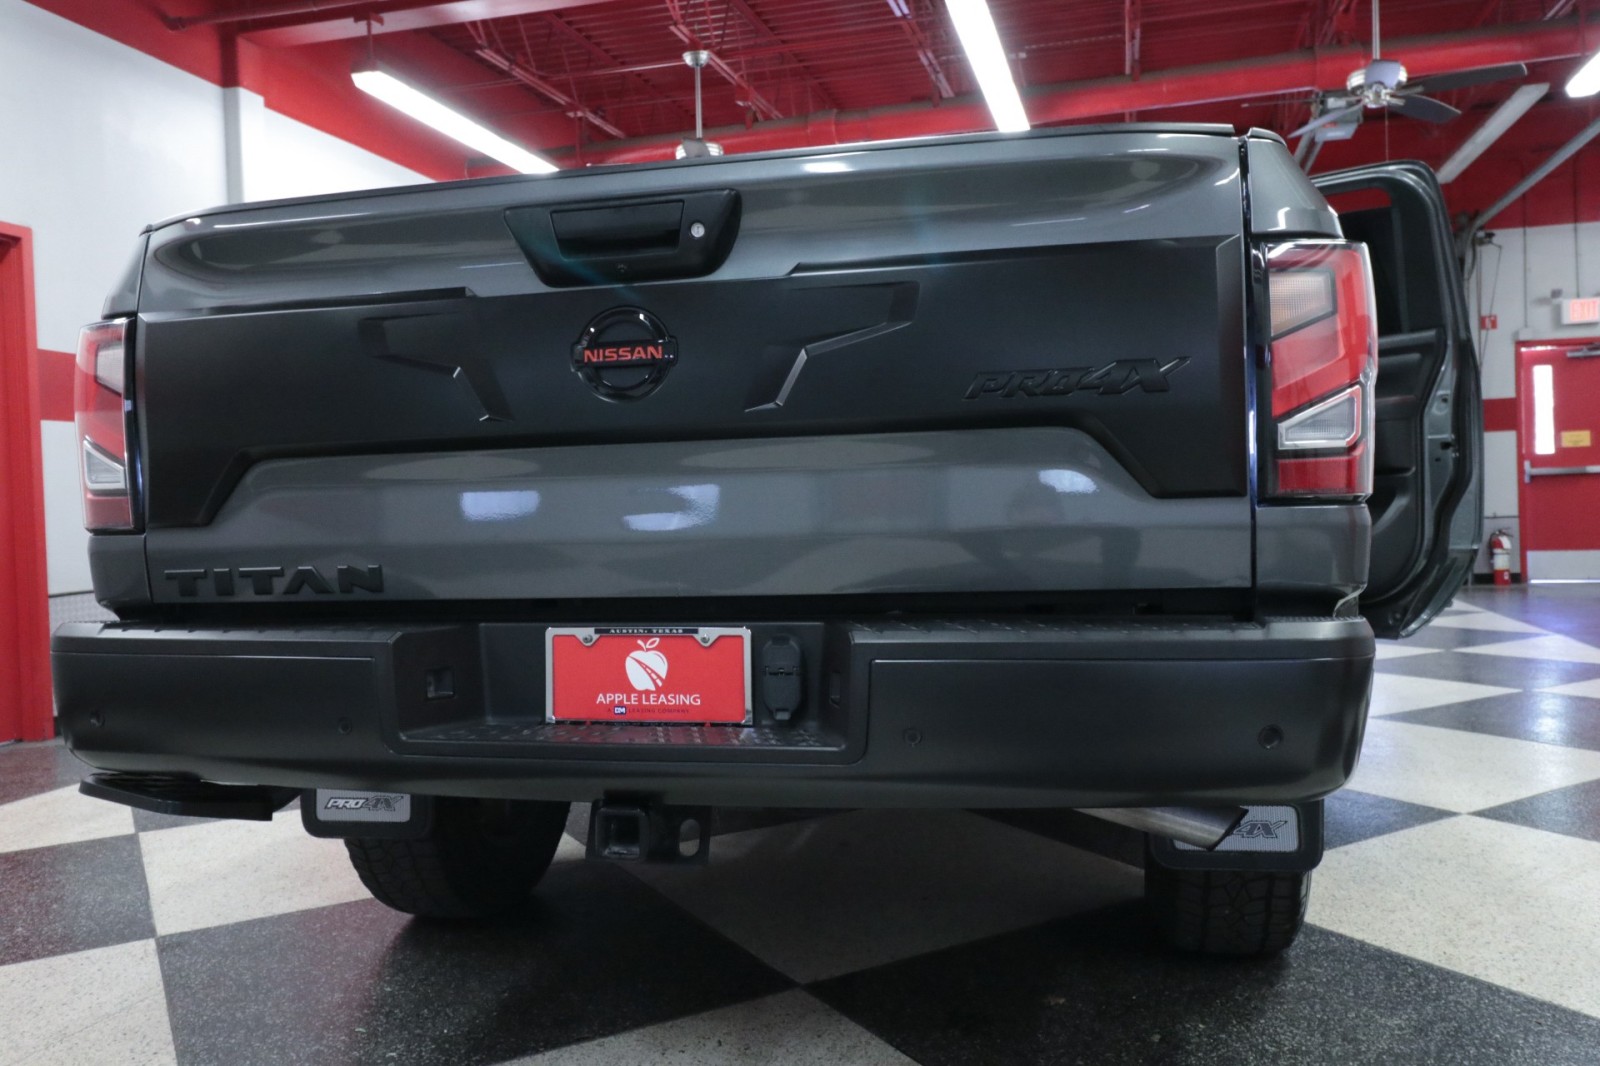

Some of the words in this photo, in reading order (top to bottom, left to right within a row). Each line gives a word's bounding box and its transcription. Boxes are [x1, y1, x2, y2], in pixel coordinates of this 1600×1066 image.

[1570, 299, 1598, 321] EXIT
[583, 345, 663, 363] NISSAN
[164, 564, 384, 597] TITAN
[596, 693, 639, 705] APPLE
[642, 694, 701, 706] LEASING
